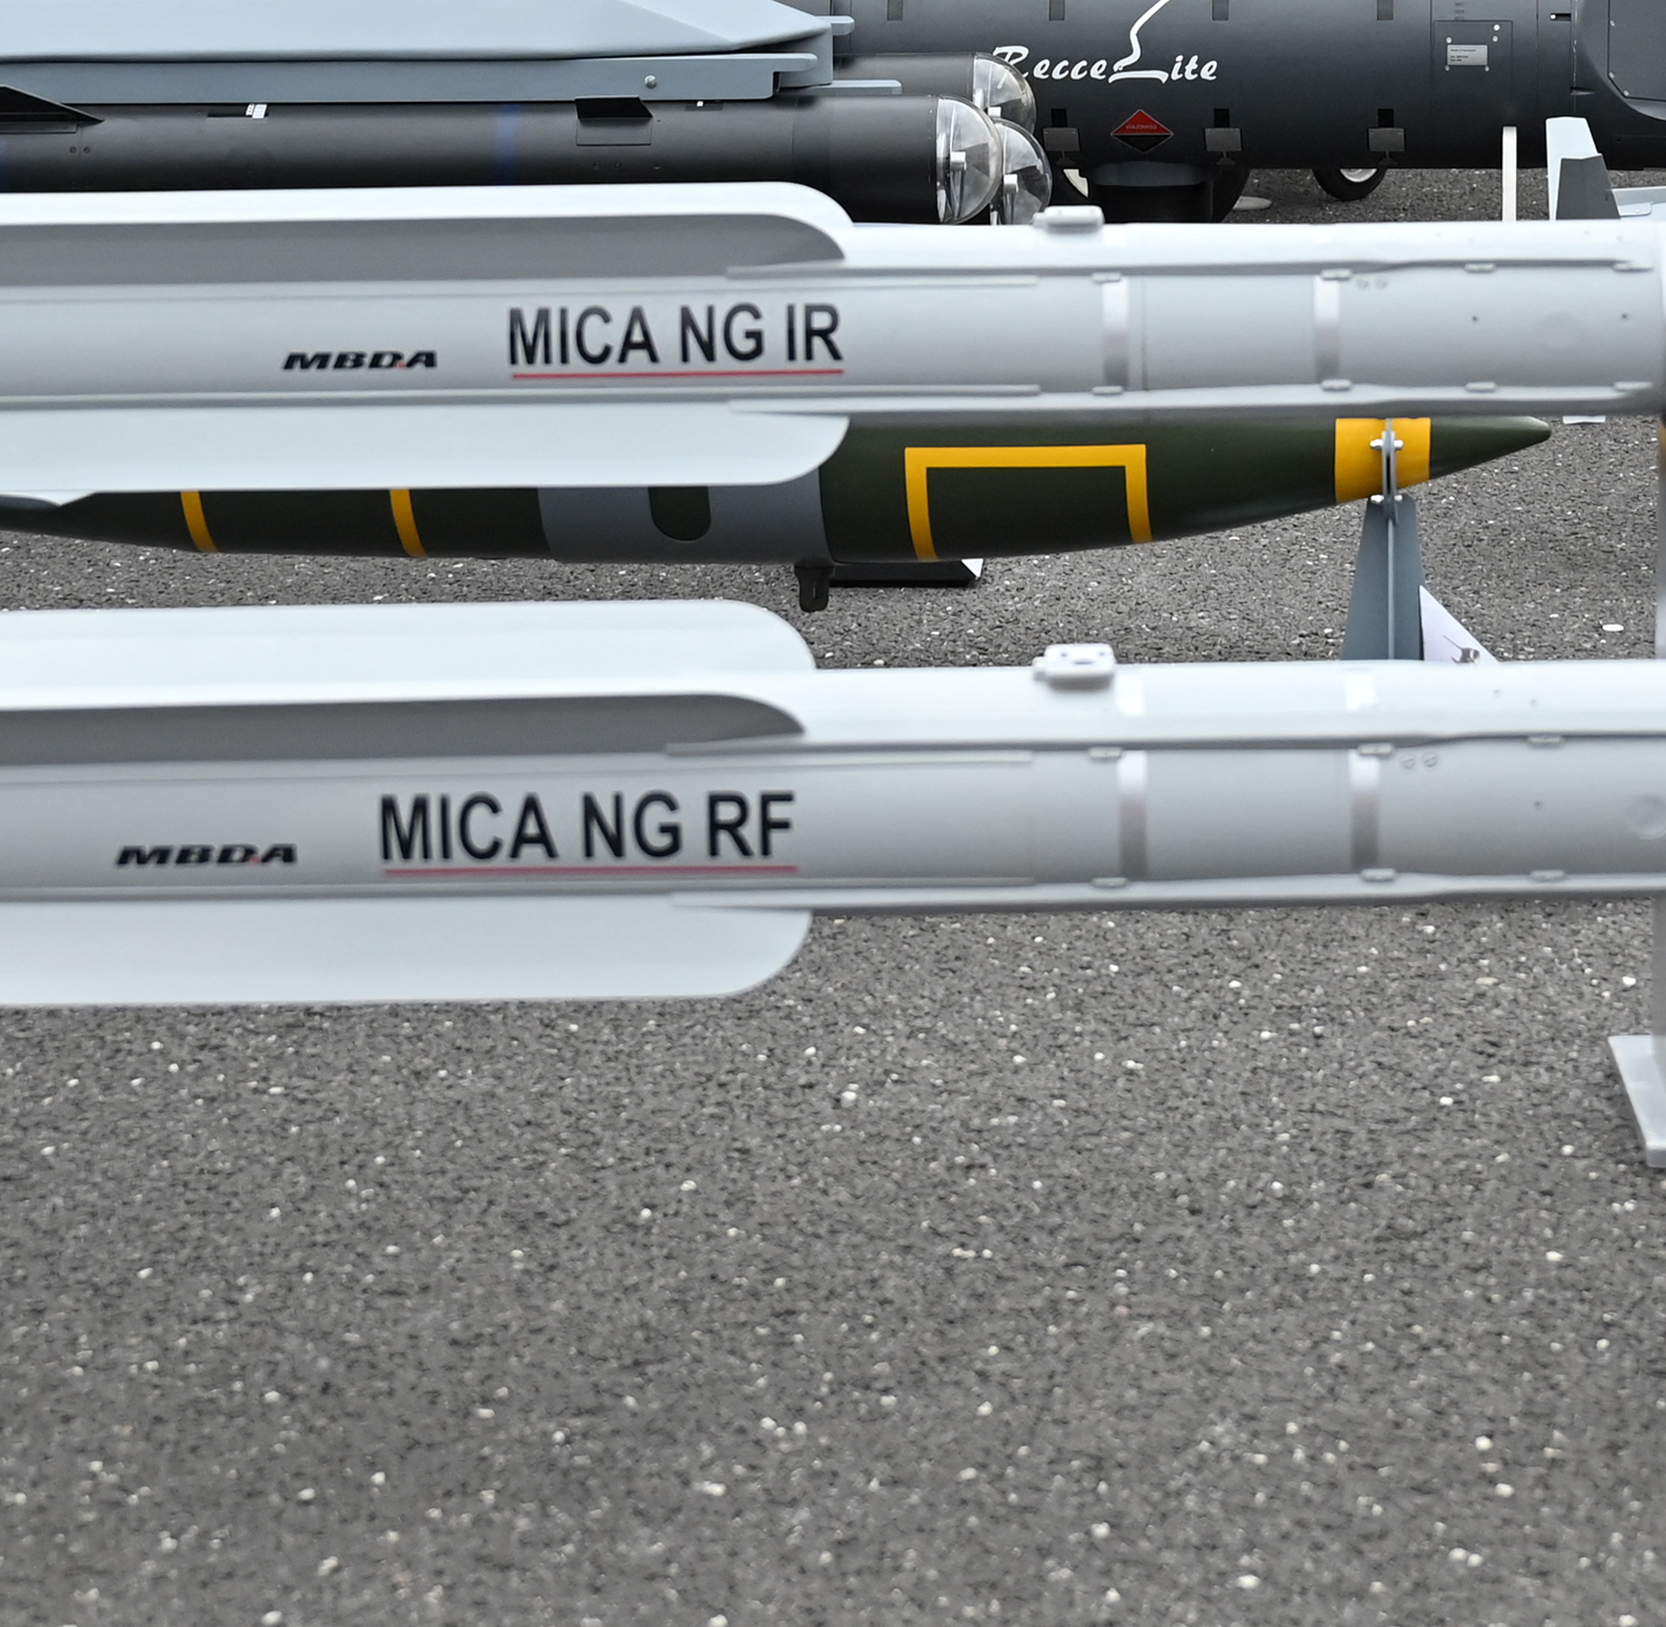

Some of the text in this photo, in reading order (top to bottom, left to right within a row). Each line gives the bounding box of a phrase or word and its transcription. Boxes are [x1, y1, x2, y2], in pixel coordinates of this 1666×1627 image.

[508, 303, 844, 366] MICA NG IR
[283, 350, 438, 371] MBDA
[380, 790, 796, 862] MICA NG RF
[116, 843, 297, 866] MBDA
